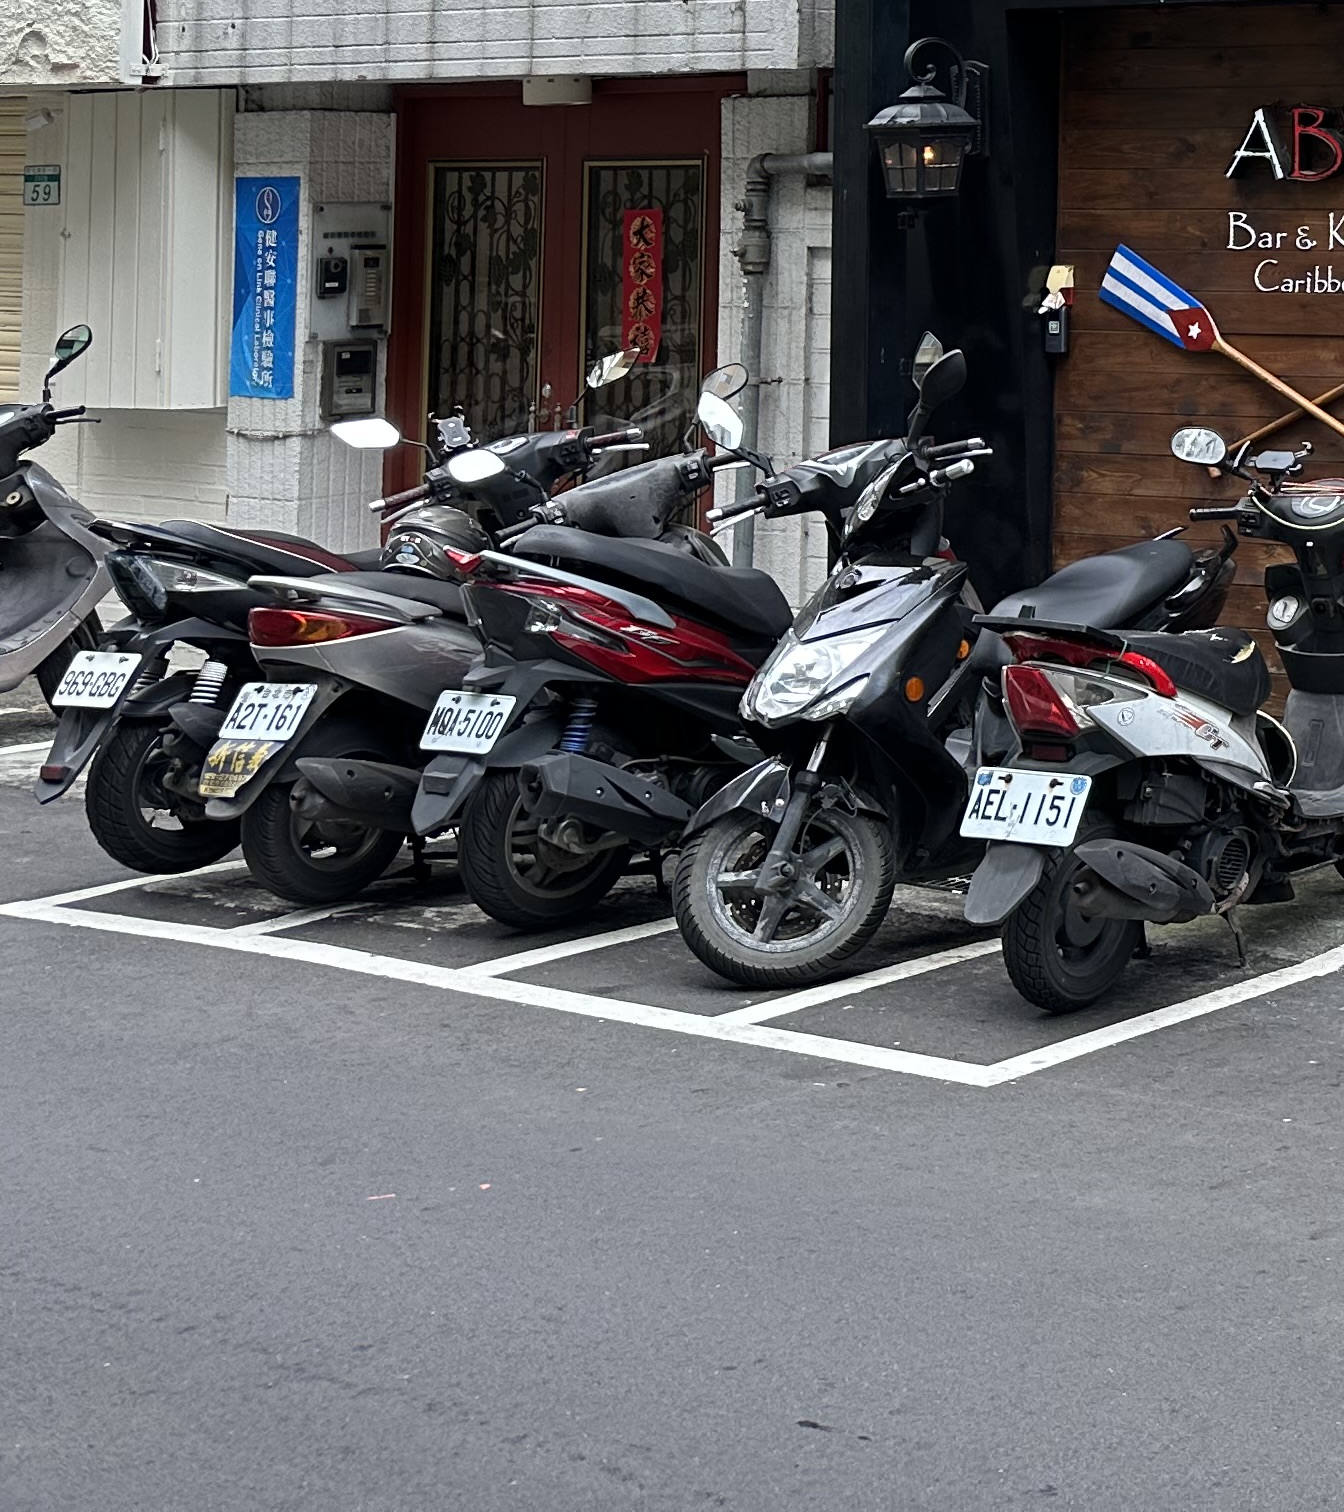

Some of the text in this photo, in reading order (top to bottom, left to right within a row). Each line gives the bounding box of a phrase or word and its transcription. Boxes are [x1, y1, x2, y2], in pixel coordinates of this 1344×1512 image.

[31, 184, 51, 202] 59
[1226, 211, 1287, 251] Bar
[1295, 225, 1317, 250] &
